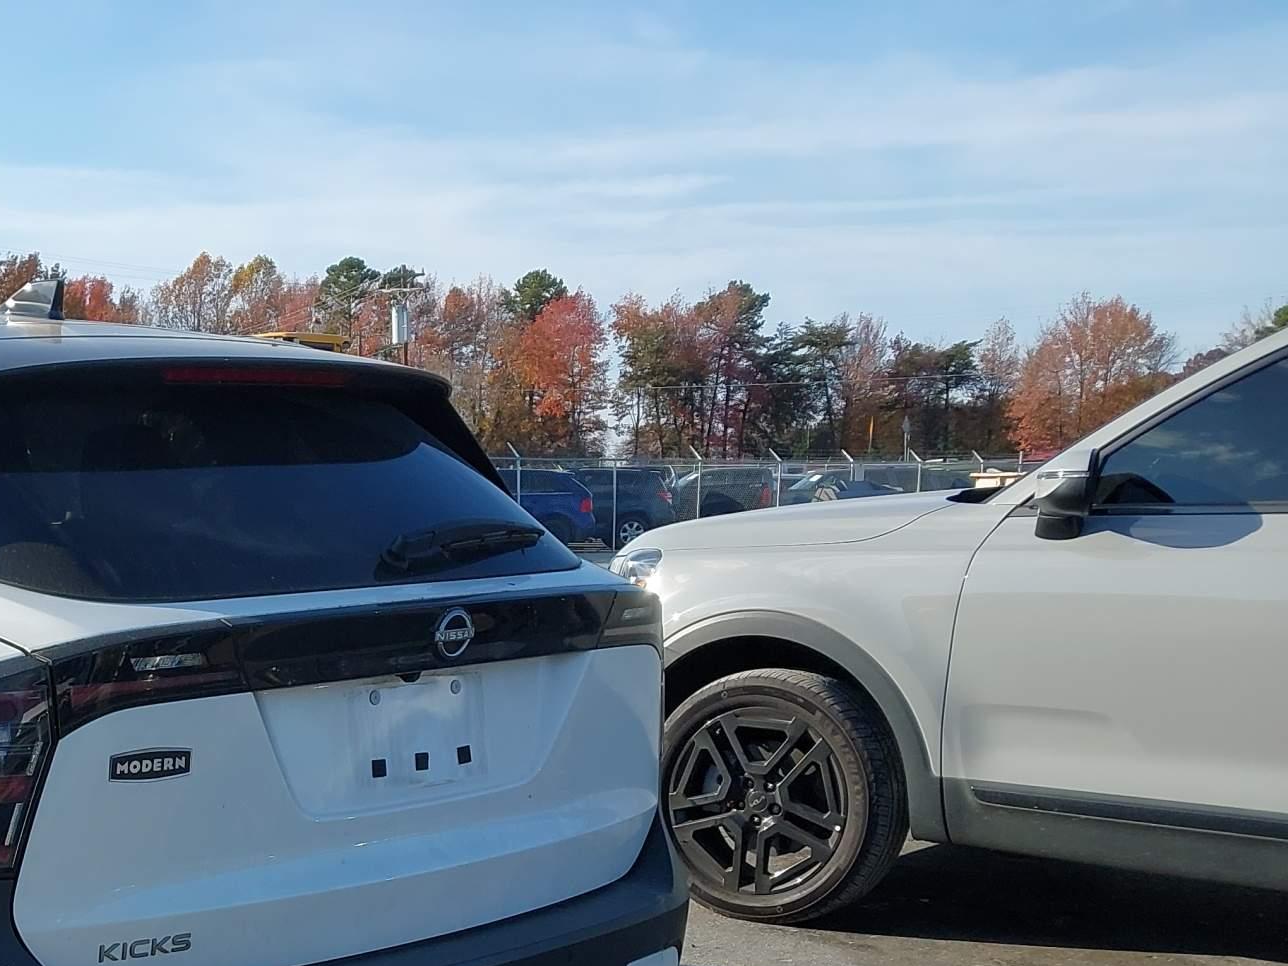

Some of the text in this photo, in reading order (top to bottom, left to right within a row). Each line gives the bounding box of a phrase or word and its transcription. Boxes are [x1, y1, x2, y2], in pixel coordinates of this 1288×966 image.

[435, 627, 475, 641] NISSAN
[116, 756, 186, 775] MODERN
[98, 933, 192, 963] KICKS
